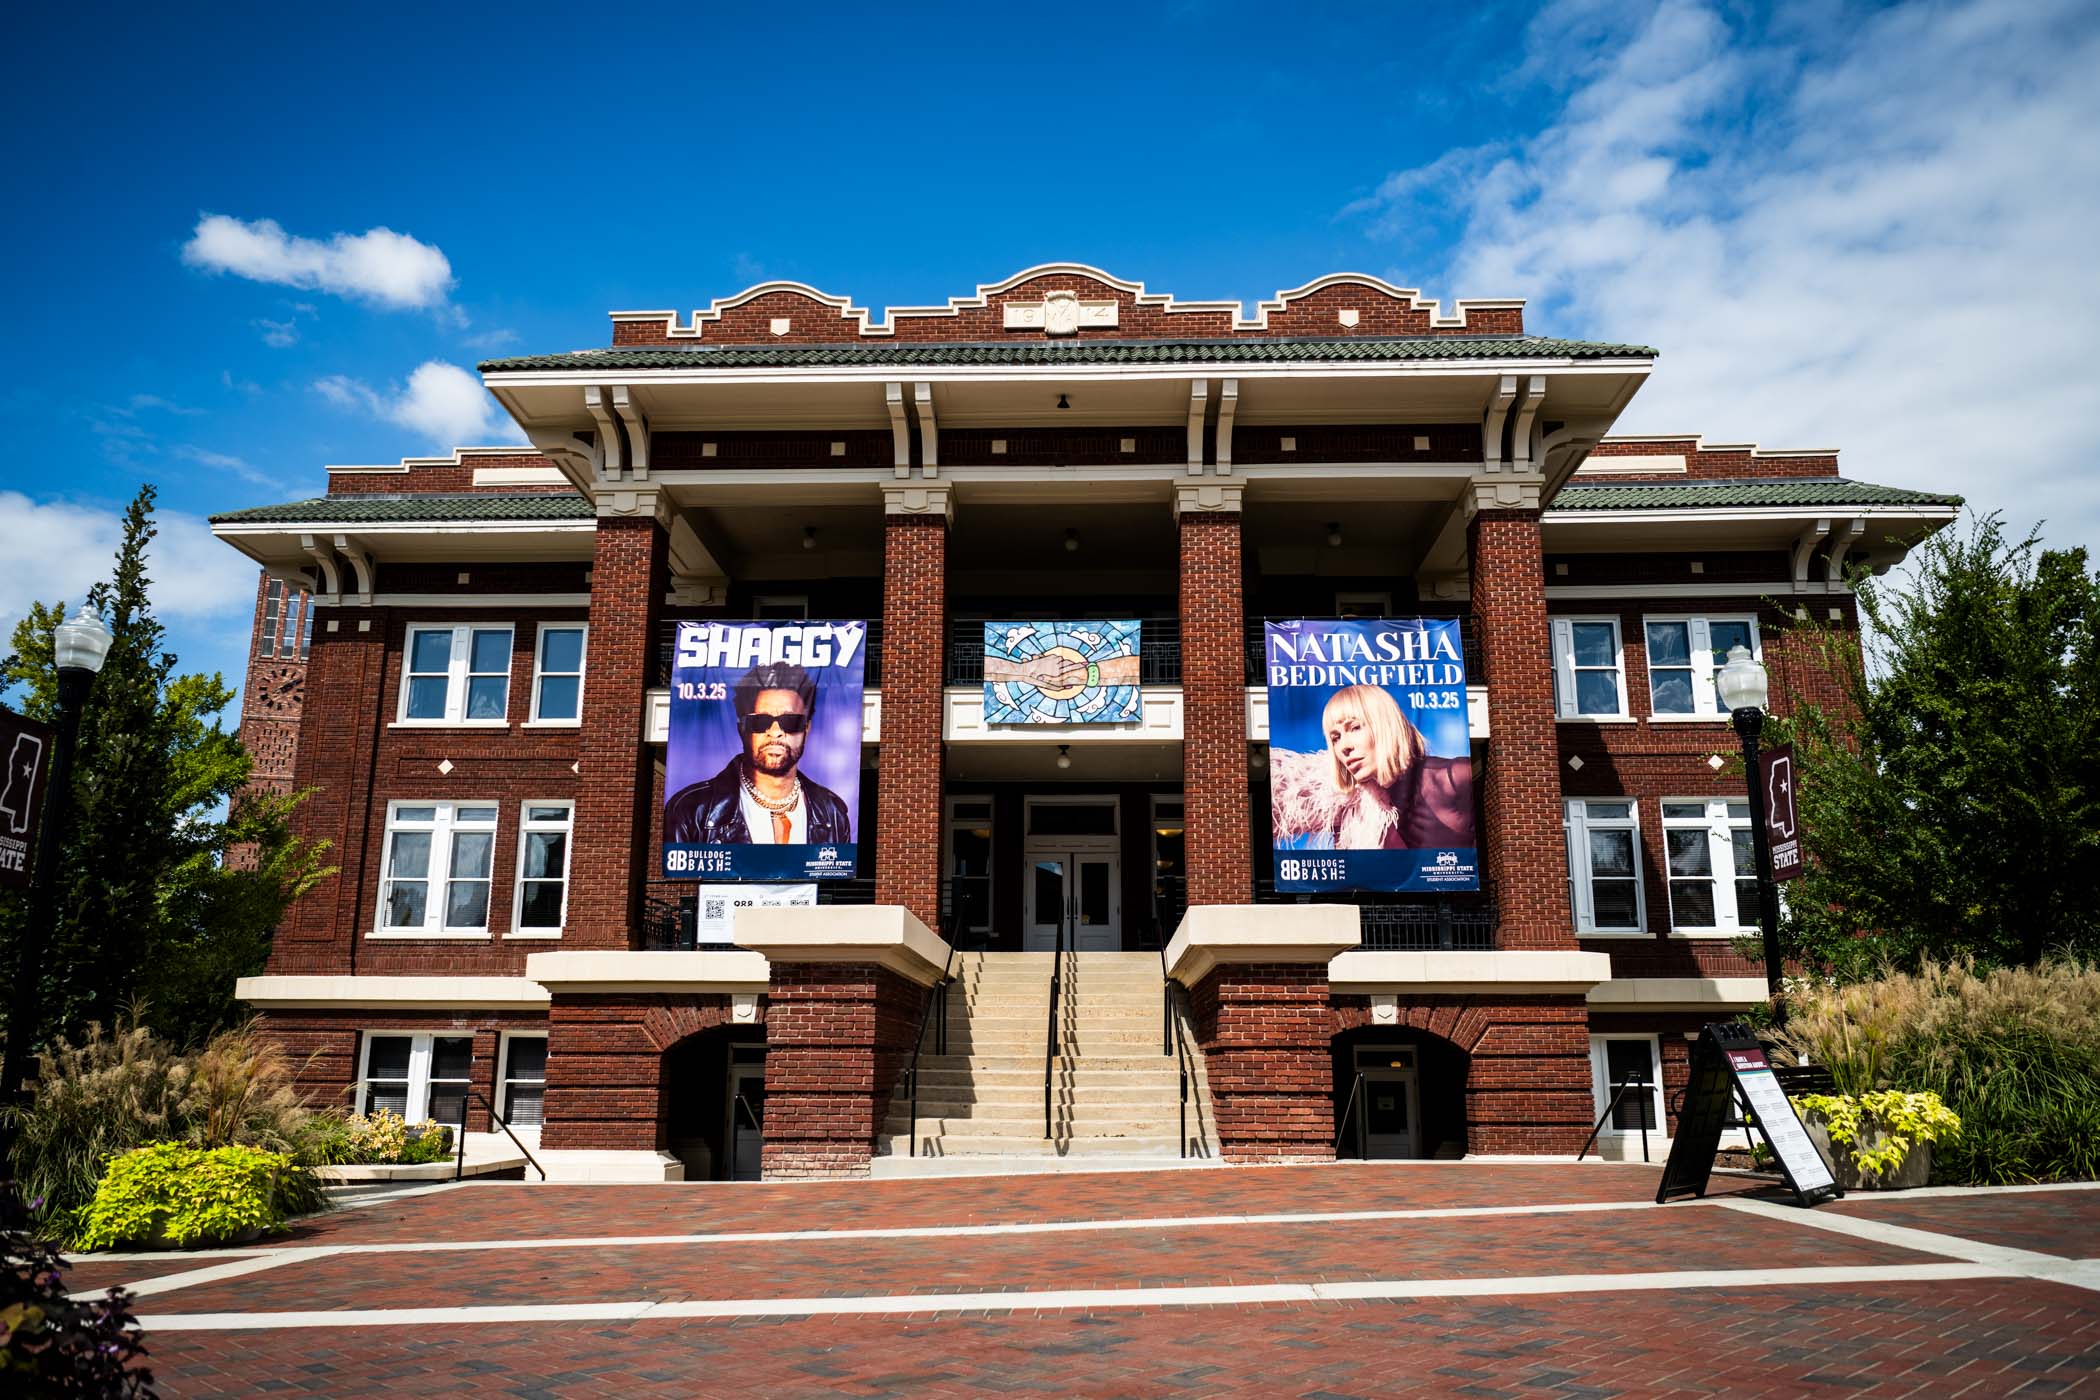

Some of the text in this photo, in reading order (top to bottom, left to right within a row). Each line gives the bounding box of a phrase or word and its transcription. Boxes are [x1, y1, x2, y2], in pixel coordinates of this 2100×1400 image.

[678, 625, 863, 668] SHAGGY
[1271, 630, 1461, 663] NATASHA
[1270, 664, 1463, 686] BEDINGFIELD
[678, 683, 727, 699] 10.3.25
[1408, 691, 1459, 709] 10.3.25
[0, 847, 26, 872] ATE
[688, 850, 724, 859] BULLDOG
[1301, 859, 1337, 868] BULLDOG
[1773, 848, 1799, 870] STATE
[688, 859, 723, 871] BASH
[1302, 868, 1337, 880] BASH
